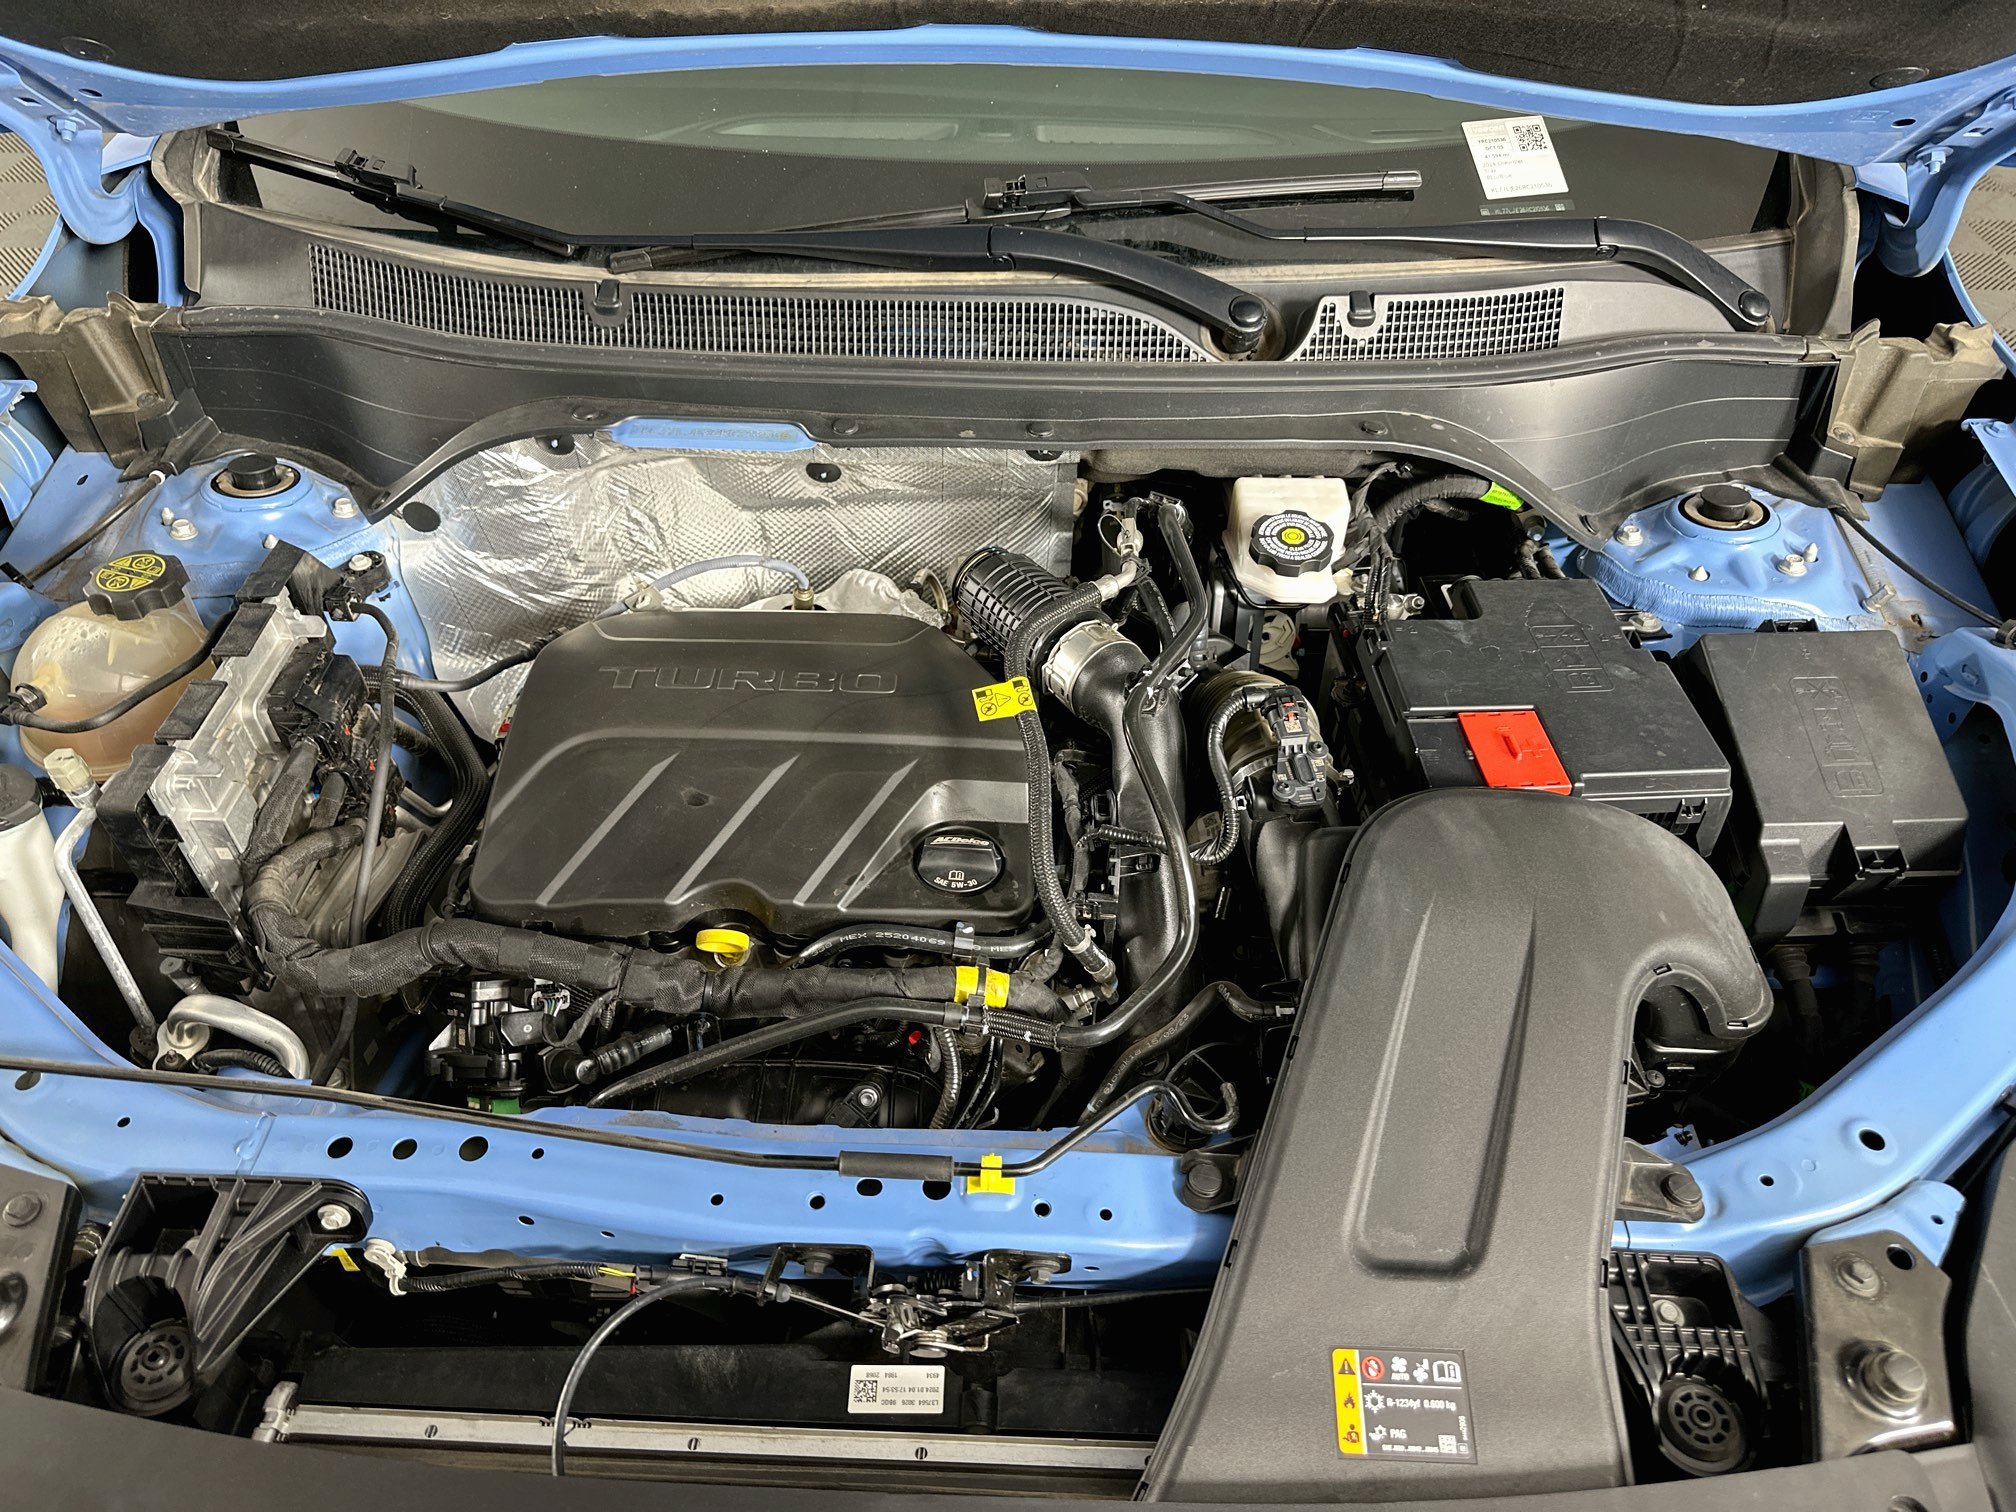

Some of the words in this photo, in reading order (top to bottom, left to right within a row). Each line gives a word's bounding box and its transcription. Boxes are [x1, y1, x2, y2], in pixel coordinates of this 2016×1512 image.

[598, 666, 898, 694] TURBO
[930, 836, 990, 846] ACDelco
[933, 876, 948, 887] SAE
[950, 879, 978, 889] 5W-30
[839, 932, 867, 943] MEX
[875, 931, 946, 946] 25204069
[1391, 1372, 1410, 1380] AUTO
[1386, 1398, 1421, 1410] R-1234yf
[1446, 1400, 1456, 1411] kg
[1390, 1428, 1407, 1438] PAG
